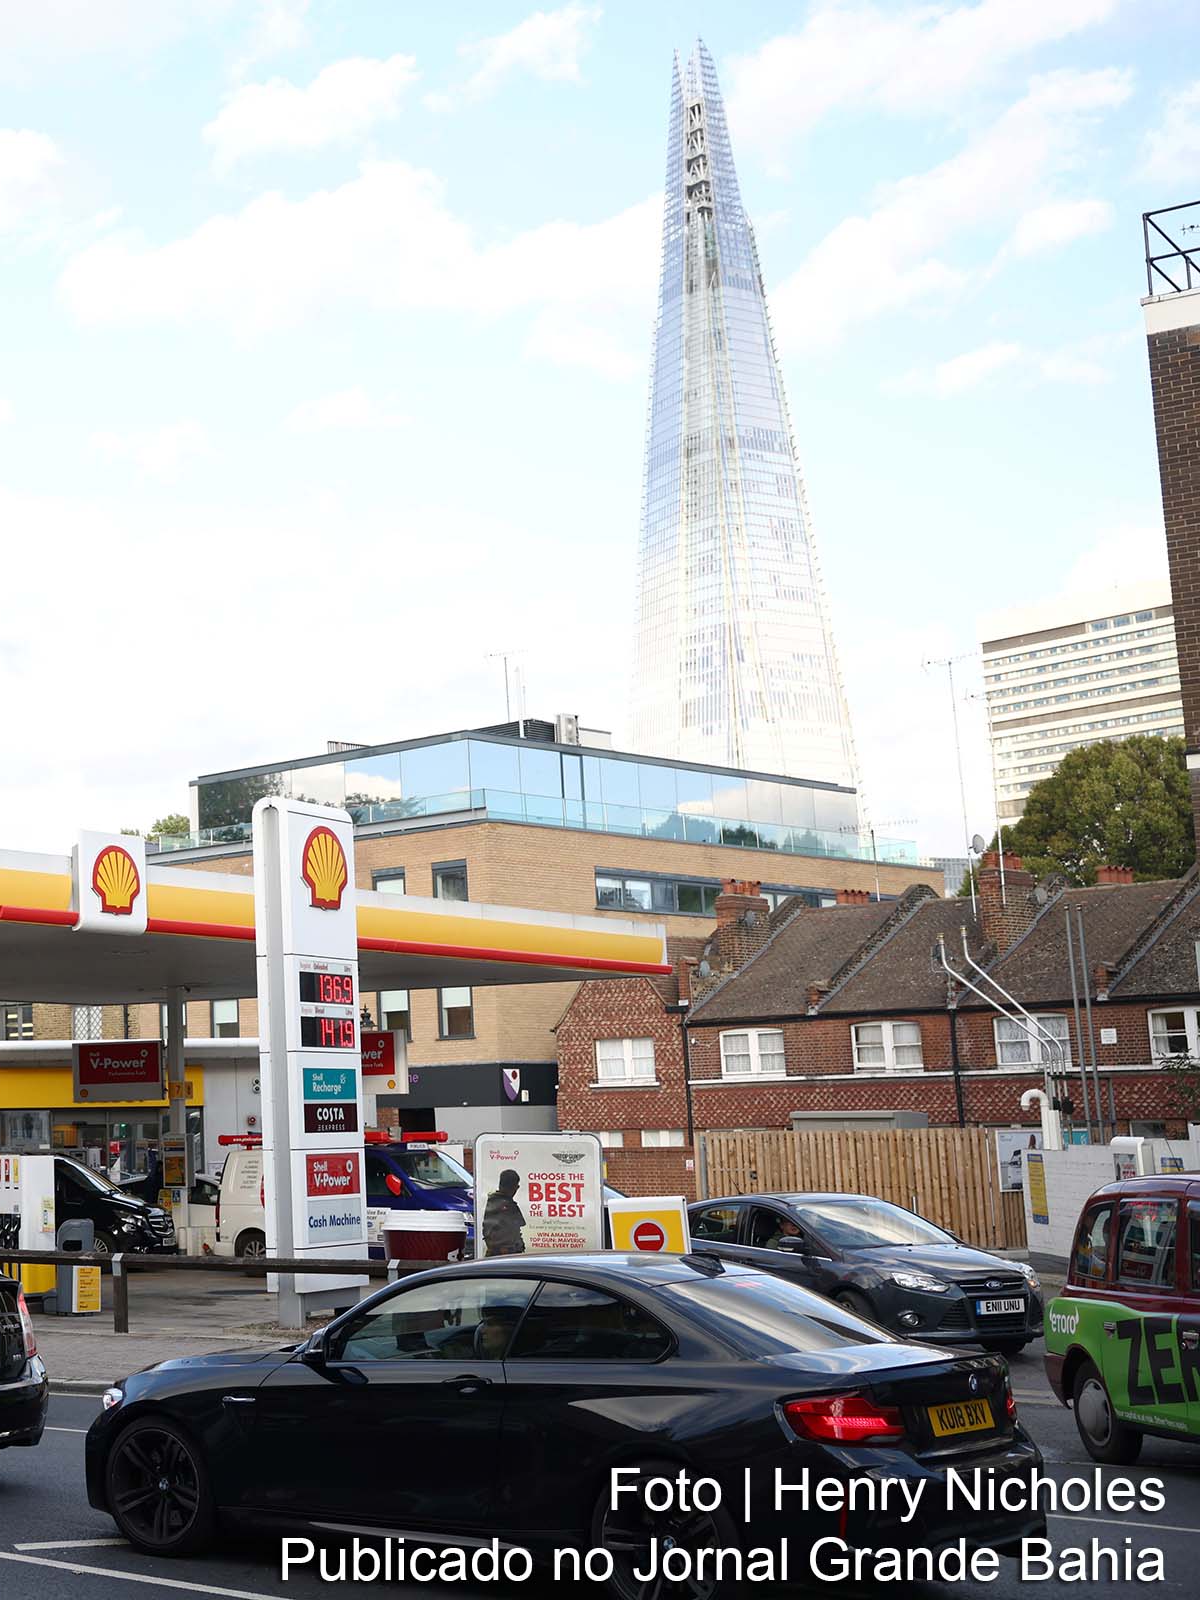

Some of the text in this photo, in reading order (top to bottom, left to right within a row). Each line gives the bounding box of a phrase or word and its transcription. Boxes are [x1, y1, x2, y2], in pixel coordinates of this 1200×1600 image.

[320, 974, 352, 1003] 136.9
[321, 1018, 353, 1047] 141.9
[90, 1058, 146, 1069] V-Power
[312, 1081, 342, 1095] Recharge
[316, 1107, 345, 1122] COSTA
[313, 1161, 328, 1172] Shell
[314, 1173, 351, 1187] V-Power
[528, 1183, 585, 1202] BEST
[547, 1204, 585, 1217] BEST
[308, 1215, 327, 1228] Cash
[329, 1212, 361, 1227] Machine
[936, 1406, 966, 1431] KU18
